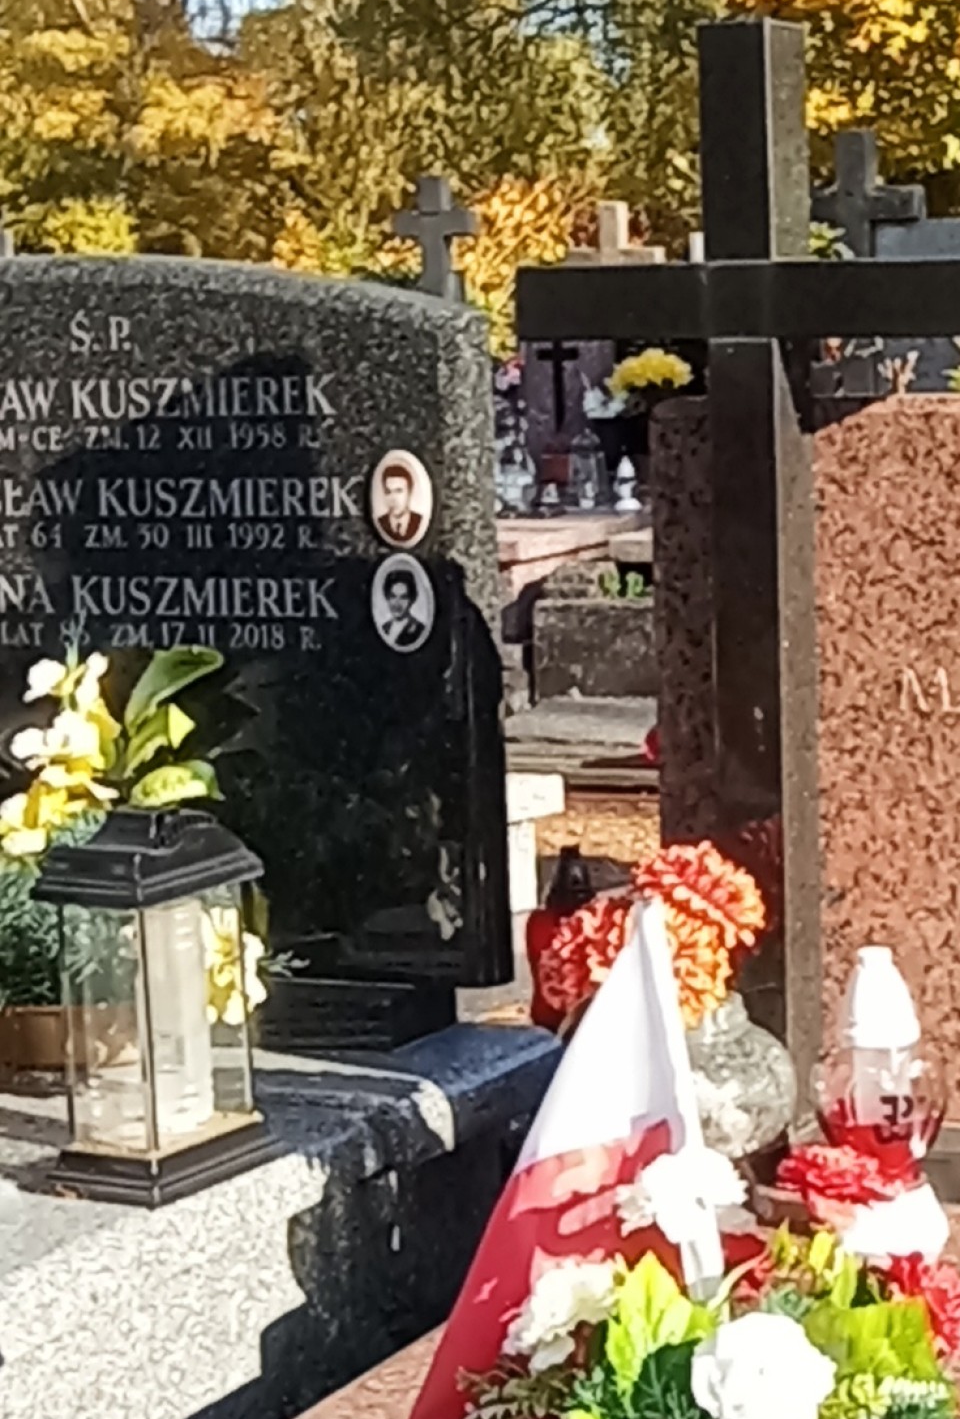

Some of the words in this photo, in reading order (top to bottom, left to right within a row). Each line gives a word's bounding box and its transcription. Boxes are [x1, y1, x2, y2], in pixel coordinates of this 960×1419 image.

[71, 373, 338, 420] KUSZMIEREK
[137, 424, 161, 450] 12
[176, 425, 213, 450] XII
[230, 422, 287, 450] 1958
[0, 478, 83, 517] ŁAW
[99, 475, 365, 519] KUSZMIEREK
[84, 523, 129, 549] ZM.
[186, 523, 213, 549] III
[228, 521, 285, 550] 1992
[71, 574, 339, 619] KUSZMIEREK
[161, 620, 185, 648] 17
[198, 624, 216, 648] II
[229, 621, 286, 650] 2018
